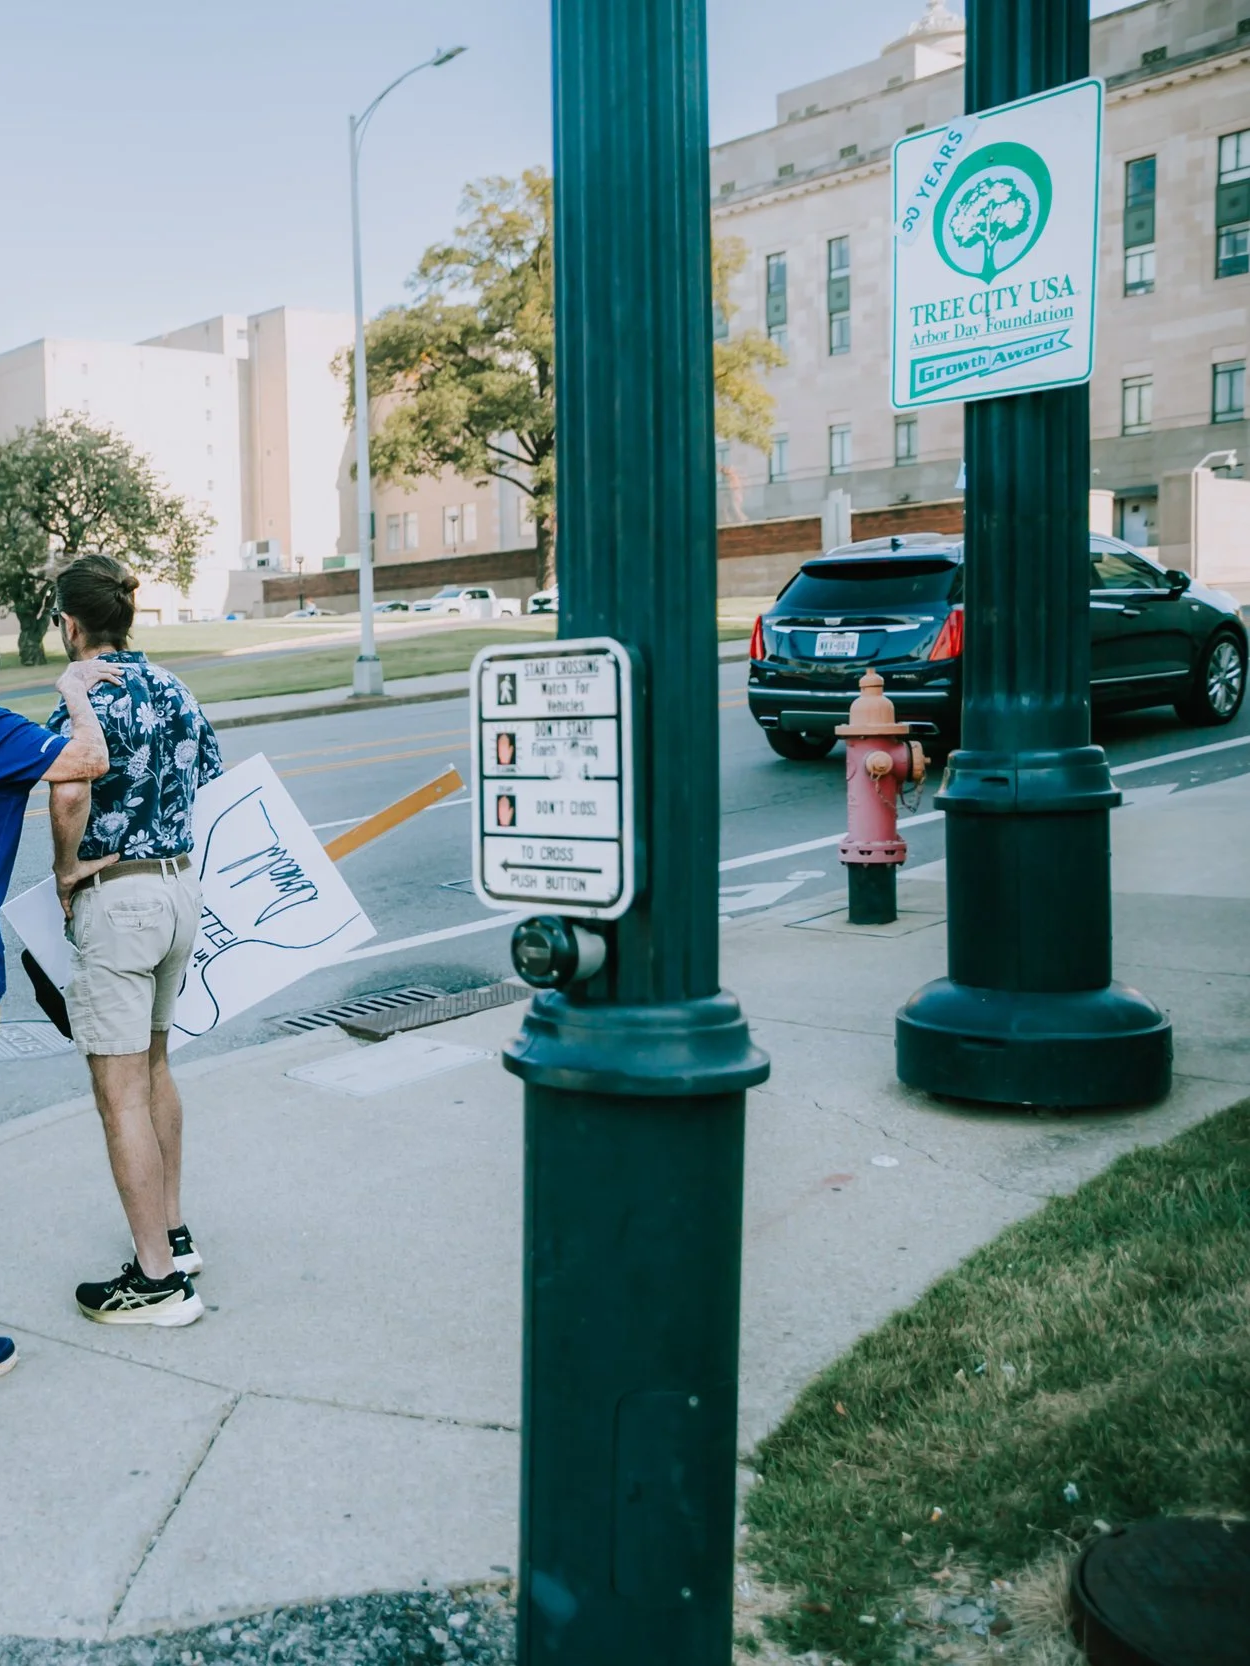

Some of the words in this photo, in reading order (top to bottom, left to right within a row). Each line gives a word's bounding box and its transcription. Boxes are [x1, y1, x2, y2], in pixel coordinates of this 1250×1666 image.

[915, 130, 963, 198] YEARS
[910, 297, 965, 327] TREE
[969, 284, 1023, 315] CITY
[1030, 274, 1074, 303] USA
[911, 329, 949, 347] Arbor
[955, 323, 981, 340] Day
[986, 305, 1074, 333] Foundation
[919, 355, 986, 384] Growth
[991, 339, 1054, 366] Award
[524, 660, 550, 677] START
[556, 658, 600, 676] CROSSING
[541, 681, 567, 696] Watch
[575, 680, 590, 695] For
[547, 699, 584, 713] Vehicles
[535, 721, 561, 737] DON'T
[566, 720, 594, 736] START
[536, 800, 564, 815] DON'T
[521, 844, 534, 860] TO
[540, 846, 574, 862] CROSS
[510, 873, 538, 888] PUSH
[545, 875, 587, 891] BUTTON
